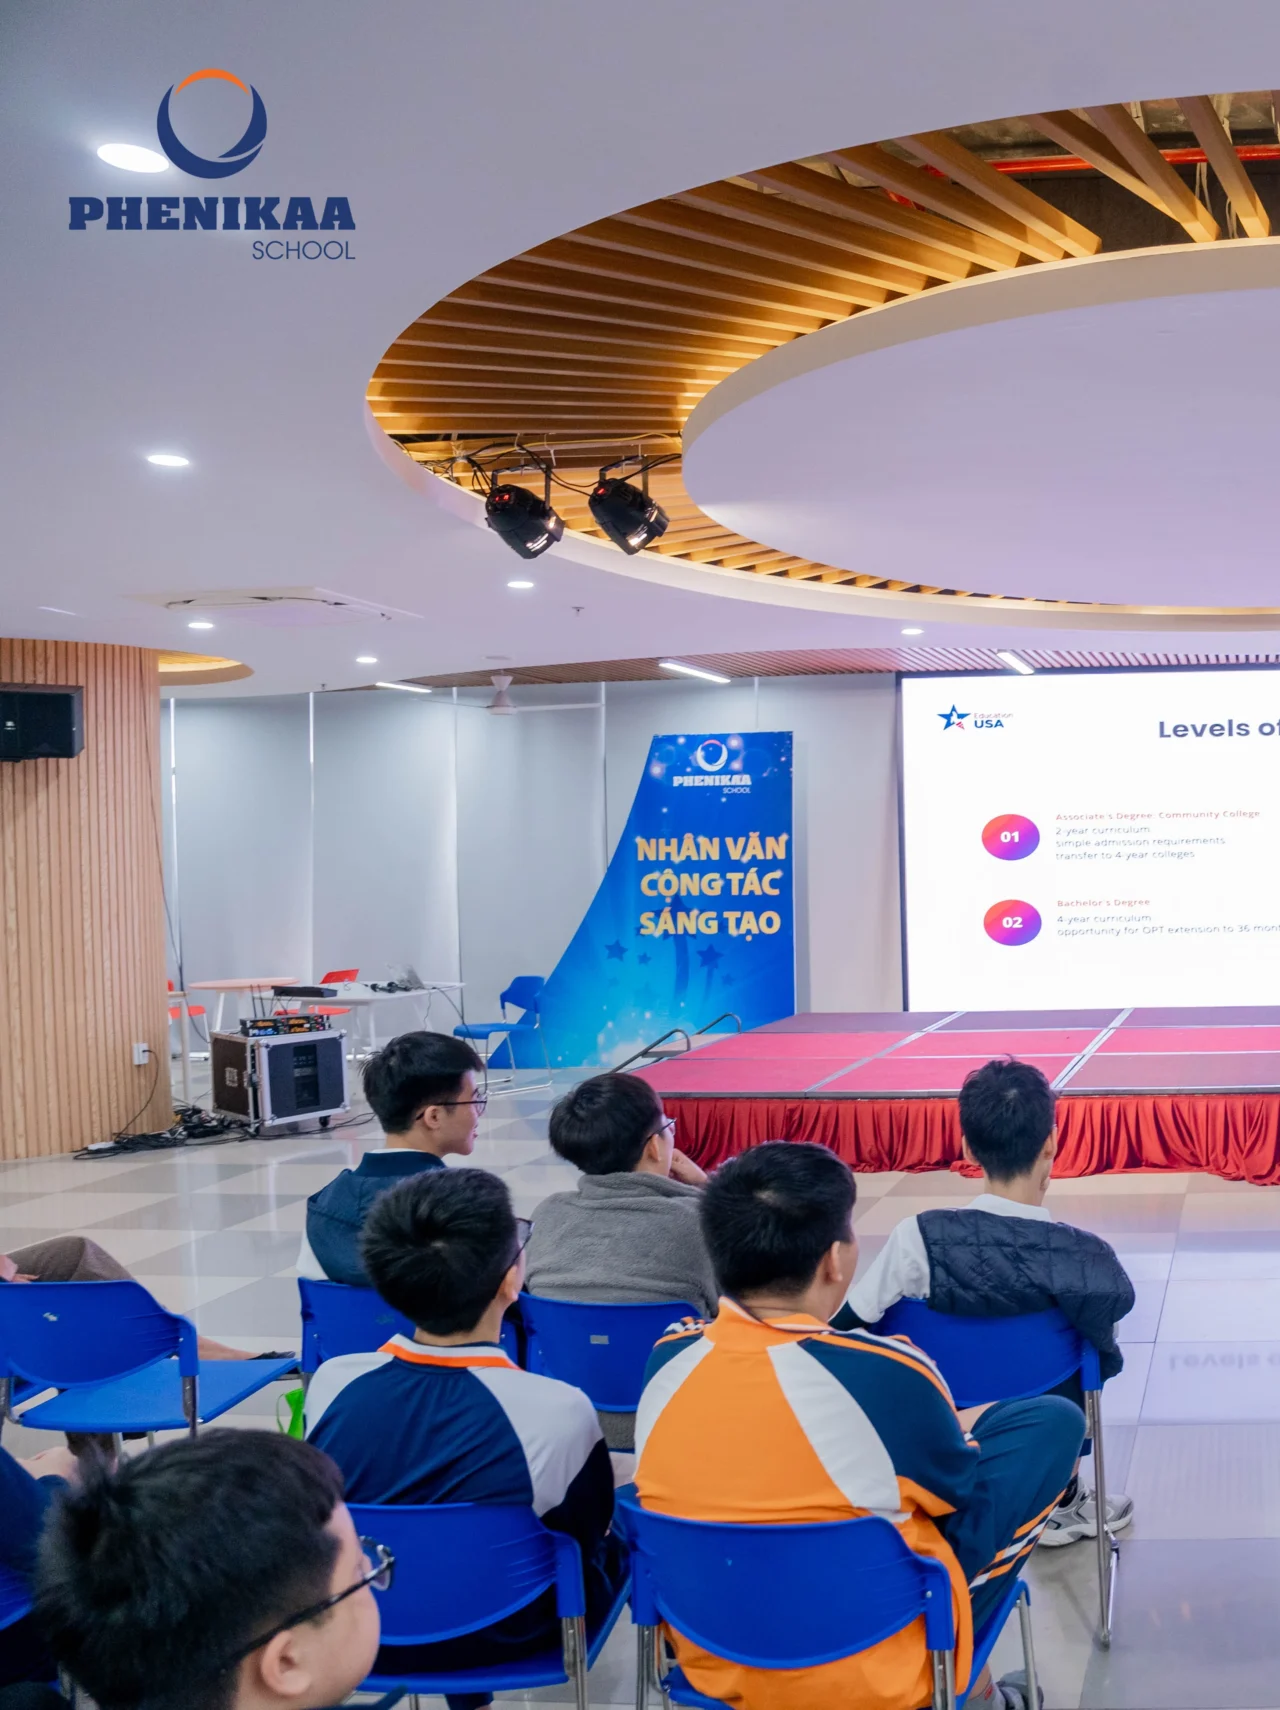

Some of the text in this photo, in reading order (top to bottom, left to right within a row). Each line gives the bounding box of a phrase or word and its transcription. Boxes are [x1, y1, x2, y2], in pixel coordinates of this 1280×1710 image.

[974, 712, 1014, 720] Education
[973, 719, 1005, 729] USA
[1158, 719, 1251, 739] Levels
[672, 774, 752, 787] PHENIKAA
[1158, 810, 1220, 821] Community
[1222, 809, 1261, 820] College
[1091, 825, 1151, 835] curriculum
[1000, 830, 1019, 843] 01
[1055, 836, 1227, 849] simple admission requirements
[637, 832, 787, 862] NHÂN VĂN
[1055, 851, 1098, 861] transfer
[1101, 851, 1113, 860] to
[1152, 849, 1196, 860] colleges
[640, 867, 781, 903] CỘNG TÁC
[1113, 898, 1151, 908] Degree
[639, 907, 781, 942] SÁNG TẠO
[1002, 917, 1023, 929] 02
[1093, 914, 1152, 924] curriculum
[1057, 926, 1121, 938] opportunity
[1123, 926, 1140, 936] for
[1142, 925, 1165, 935] OPT
[1167, 924, 1221, 935] extension
[1222, 924, 1234, 934] to
[1237, 924, 1251, 933] 36
